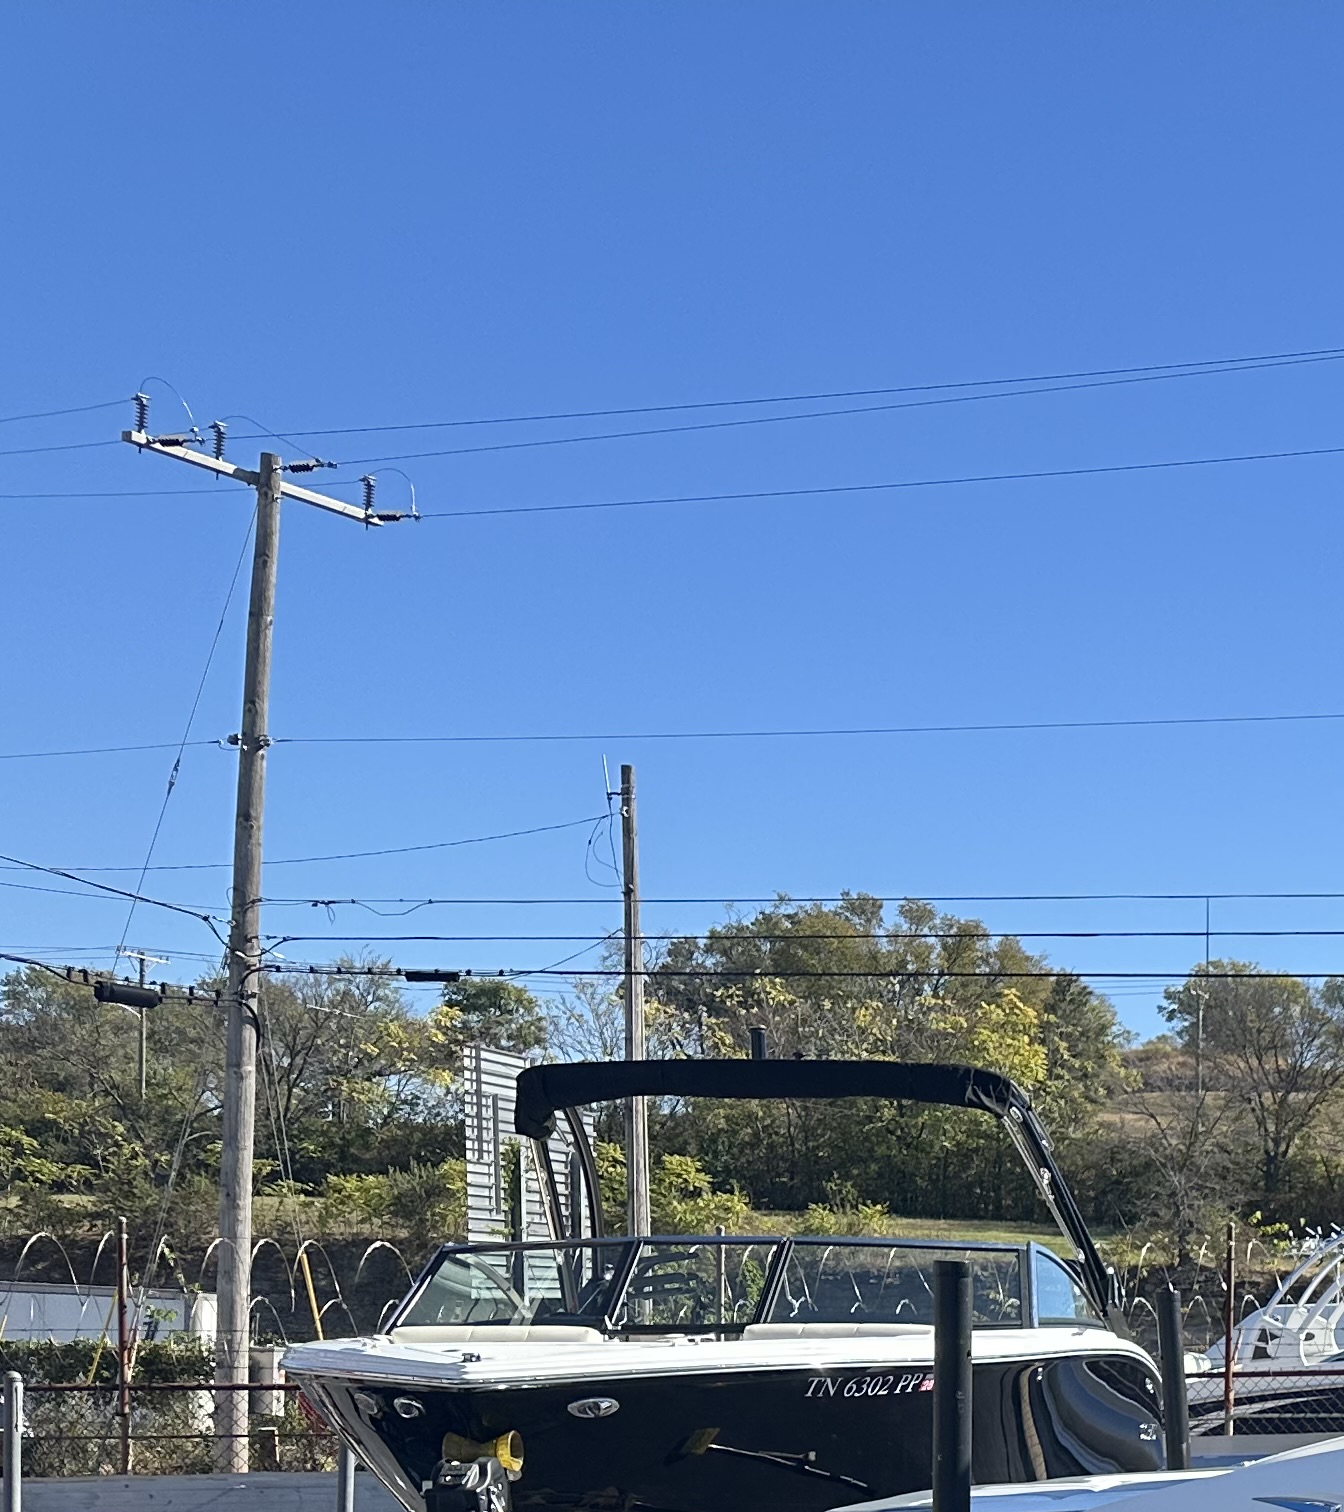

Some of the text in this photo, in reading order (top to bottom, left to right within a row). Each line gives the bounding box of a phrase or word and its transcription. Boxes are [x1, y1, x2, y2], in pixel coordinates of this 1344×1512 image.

[804, 1373, 924, 1398] TN 6302 PP
